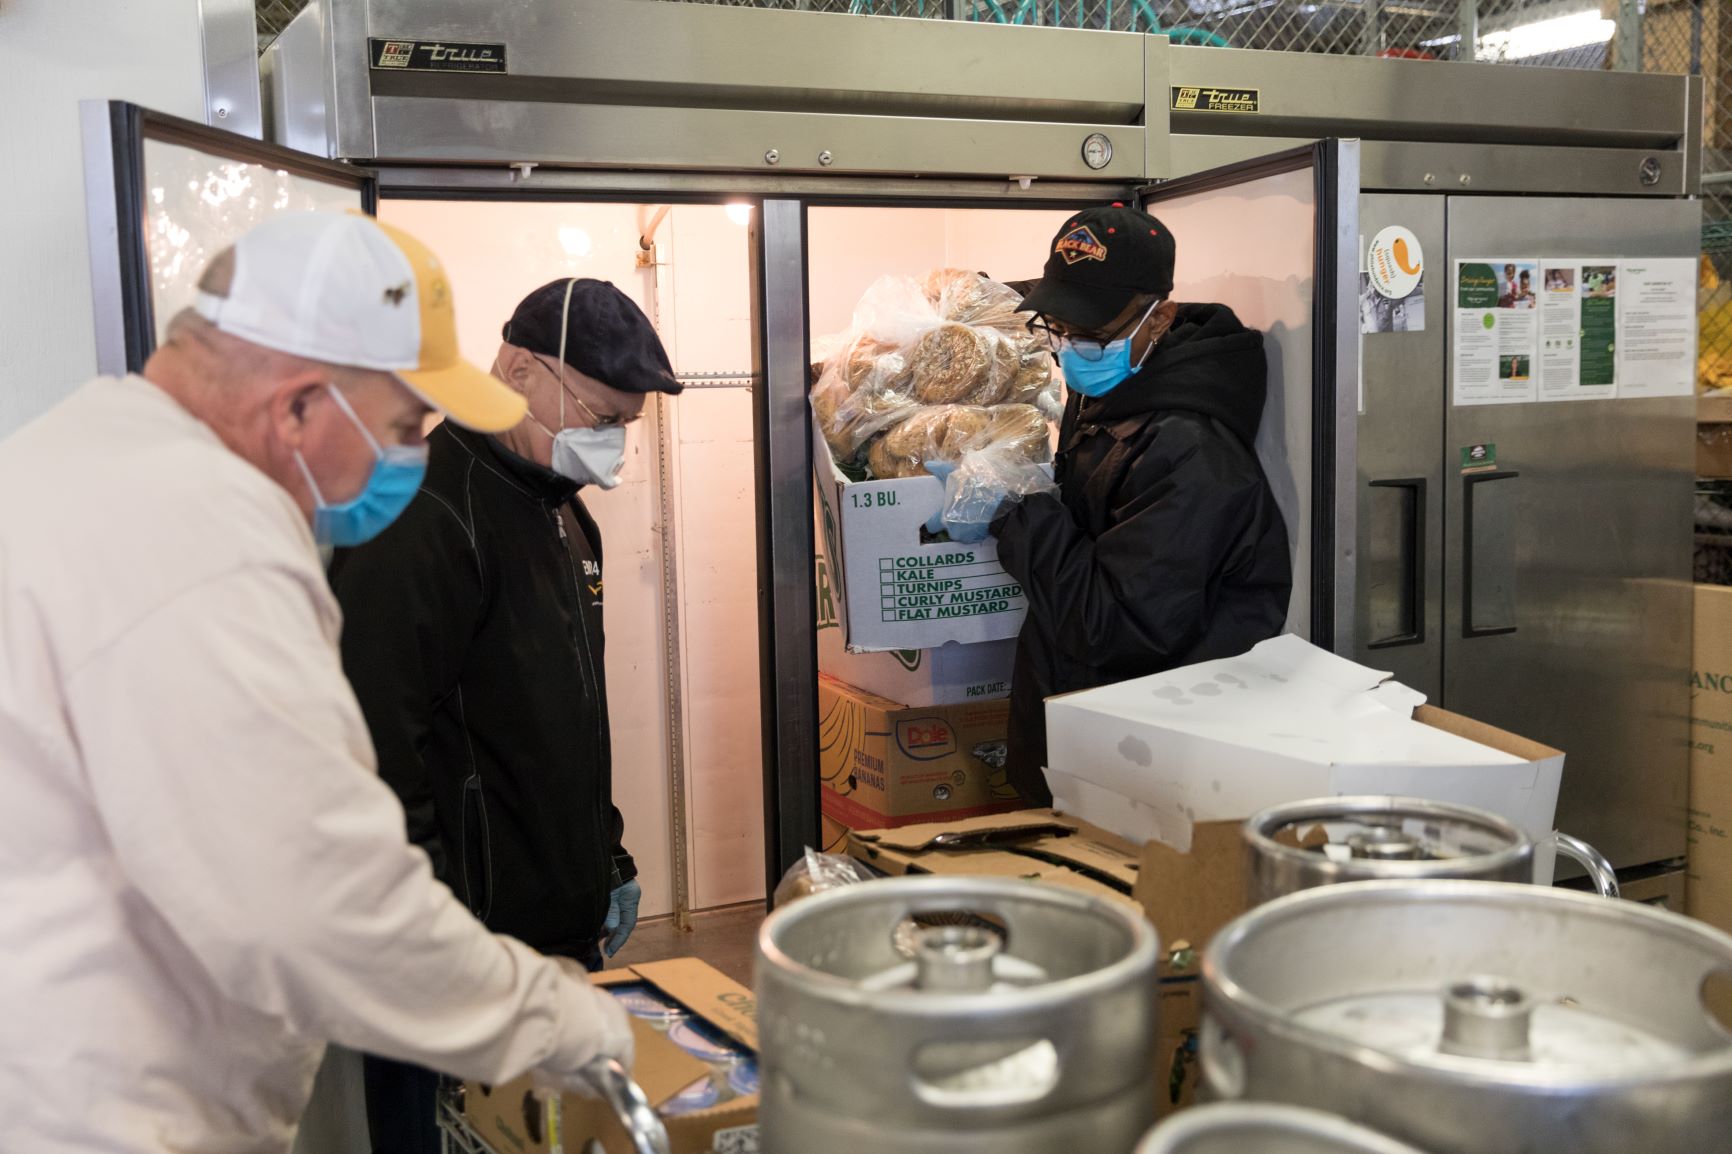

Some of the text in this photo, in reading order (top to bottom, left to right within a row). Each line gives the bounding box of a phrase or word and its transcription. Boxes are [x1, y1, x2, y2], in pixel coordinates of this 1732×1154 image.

[1208, 103, 1254, 111] FREEZER
[1080, 242, 1104, 258] BEAR
[1376, 248, 1390, 284] hunger
[851, 491, 901, 508] 1.3 BU.
[896, 552, 975, 568] COLLARDS
[897, 569, 935, 581] KALE
[897, 580, 963, 594] TURNIPS
[897, 585, 1022, 607] CURLY MUSTARD
[899, 600, 1009, 620] FLAT MUSTARD
[966, 682, 1007, 697] PACK DATE:
[908, 725, 949, 745] Dole
[854, 750, 885, 774] PREMIUM
[854, 767, 885, 792] BANANAS
